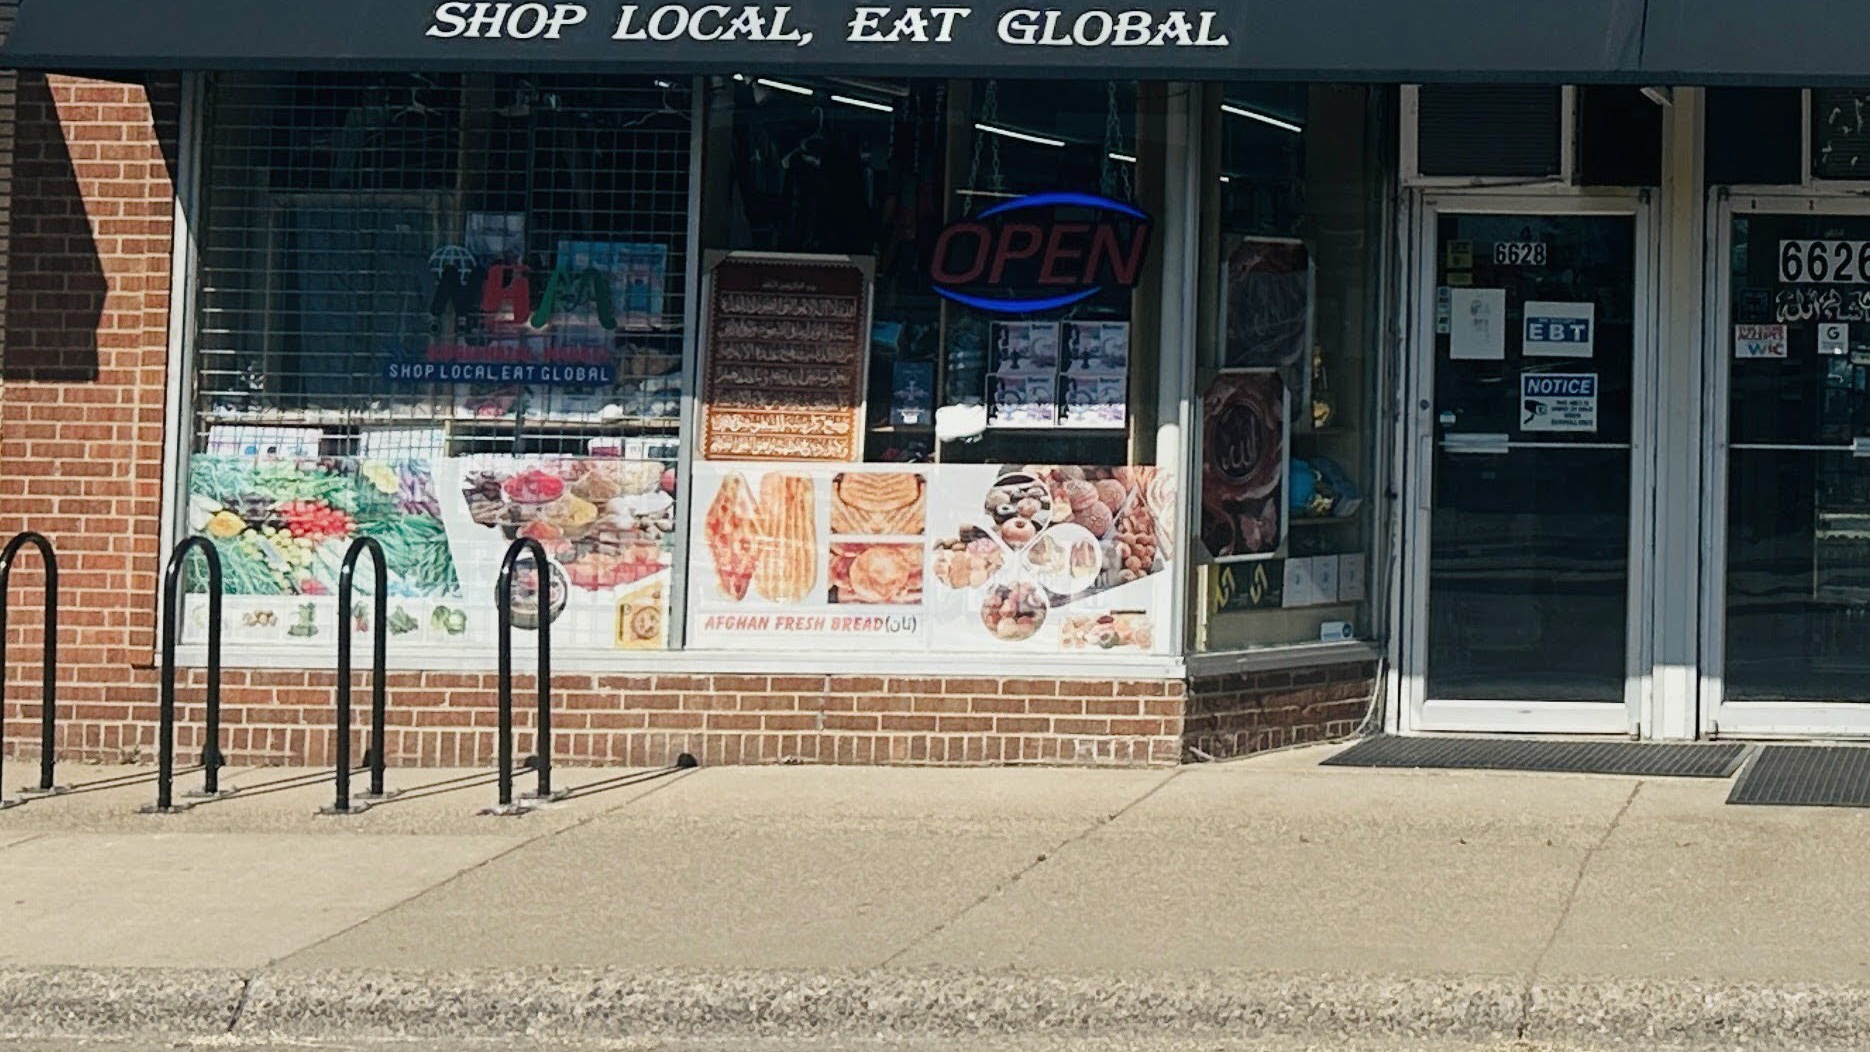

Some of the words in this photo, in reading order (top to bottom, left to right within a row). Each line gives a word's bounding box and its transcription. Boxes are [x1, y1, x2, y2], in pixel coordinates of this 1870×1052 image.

[425, 1, 588, 39] SHOP
[611, 4, 813, 46] LOCAL,
[846, 7, 972, 42] EAT
[997, 9, 1230, 46] GLOBAL
[930, 223, 1148, 286] OPEN
[1495, 243, 1546, 264] 6628
[1530, 323, 1585, 341] EBT
[389, 363, 434, 379] SHOP
[501, 365, 535, 380] EAT
[541, 366, 609, 381] GLOBAL
[1527, 379, 1591, 394] NOTICE
[704, 615, 770, 630] AFGHAN
[774, 616, 826, 631] FRESH
